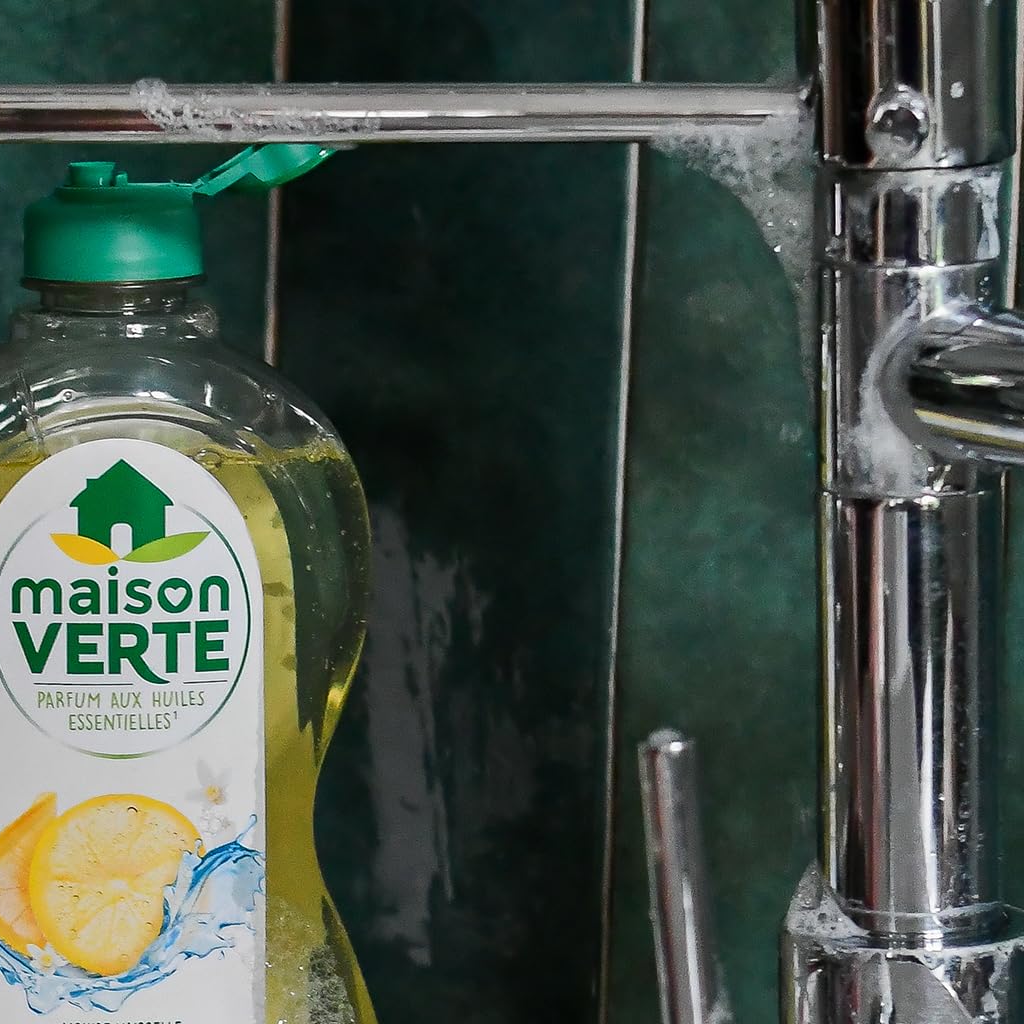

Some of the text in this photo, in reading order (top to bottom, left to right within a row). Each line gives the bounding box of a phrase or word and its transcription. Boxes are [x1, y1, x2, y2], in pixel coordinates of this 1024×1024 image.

[11, 565, 230, 615] maison
[12, 619, 230, 684] VERTE
[37, 690, 206, 709] PARFUM AUX HUILES
